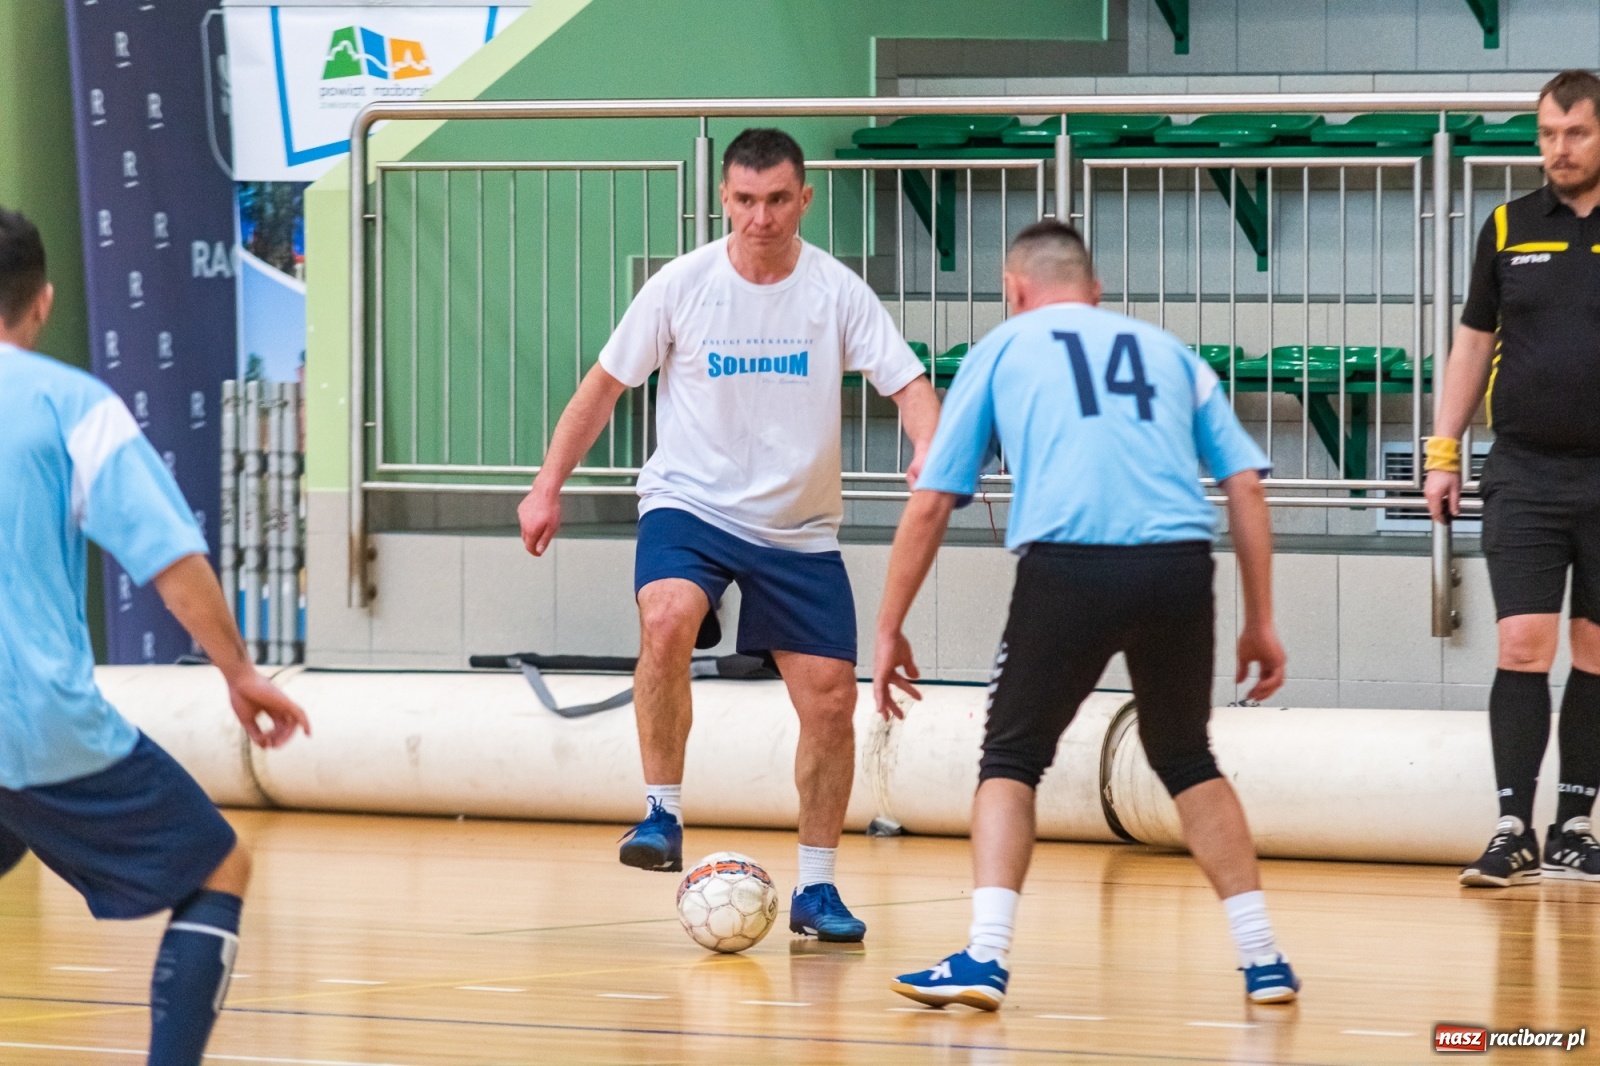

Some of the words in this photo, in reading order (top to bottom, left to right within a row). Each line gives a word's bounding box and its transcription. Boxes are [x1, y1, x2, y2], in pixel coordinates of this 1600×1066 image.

[707, 350, 808, 378] SOLIDUM
[1051, 330, 1155, 421] 14
[1558, 783, 1596, 797] zina
